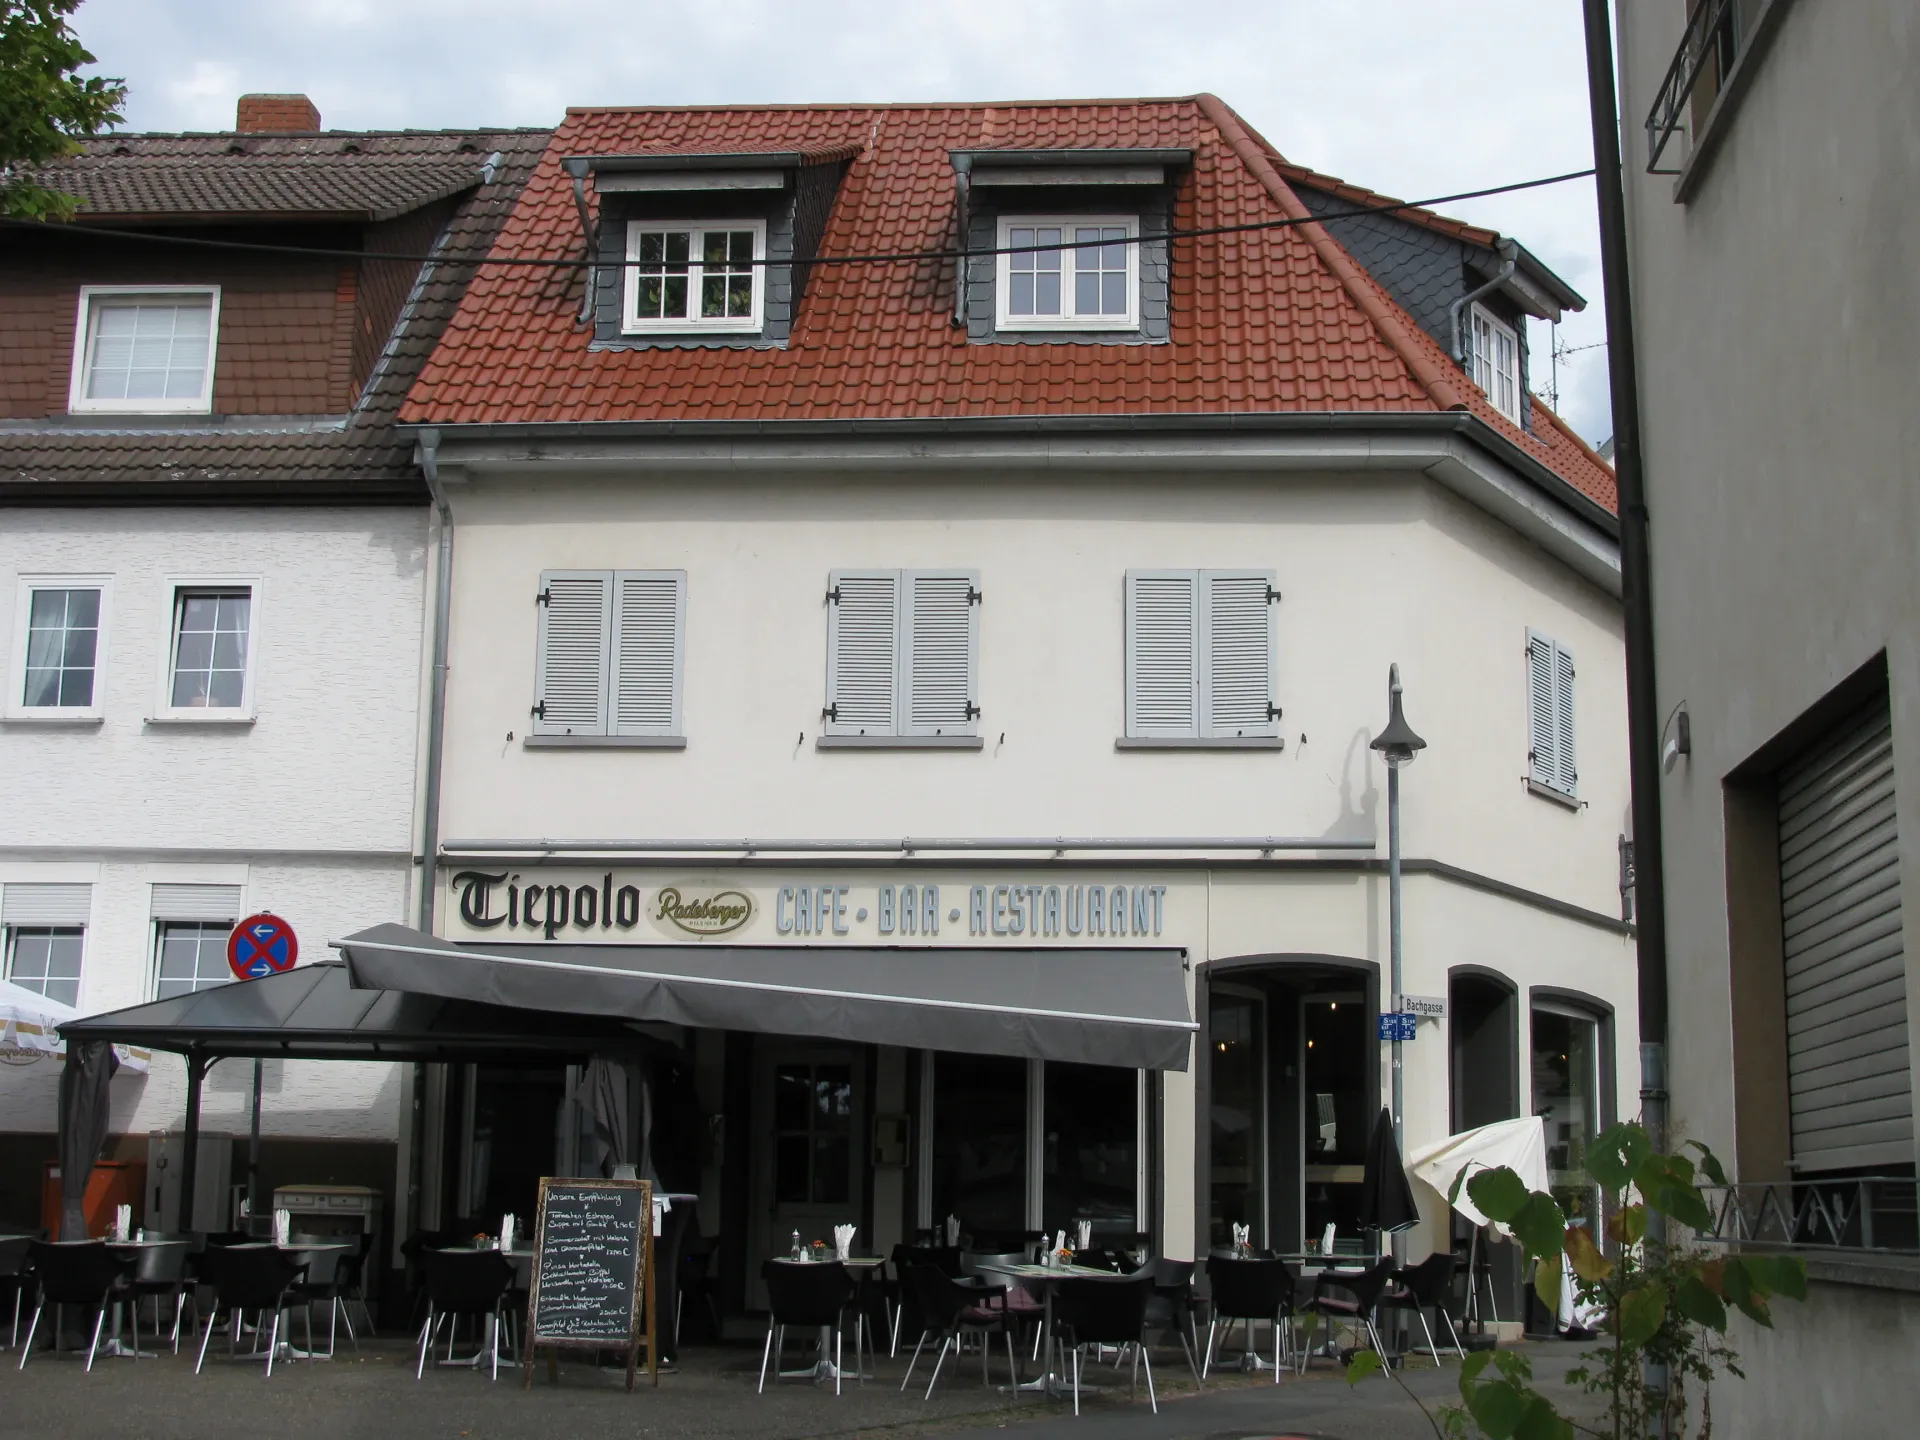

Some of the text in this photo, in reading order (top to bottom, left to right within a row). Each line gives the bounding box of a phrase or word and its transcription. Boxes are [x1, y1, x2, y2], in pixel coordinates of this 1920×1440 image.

[452, 871, 640, 940] Tiepolo
[656, 888, 750, 930] Radeberger
[776, 884, 1167, 934] CAFE BAR RESTAURANT
[1406, 998, 1444, 1015] Bachgasse
[547, 1190, 576, 1201] Unsere
[548, 1220, 570, 1229] Suppe
